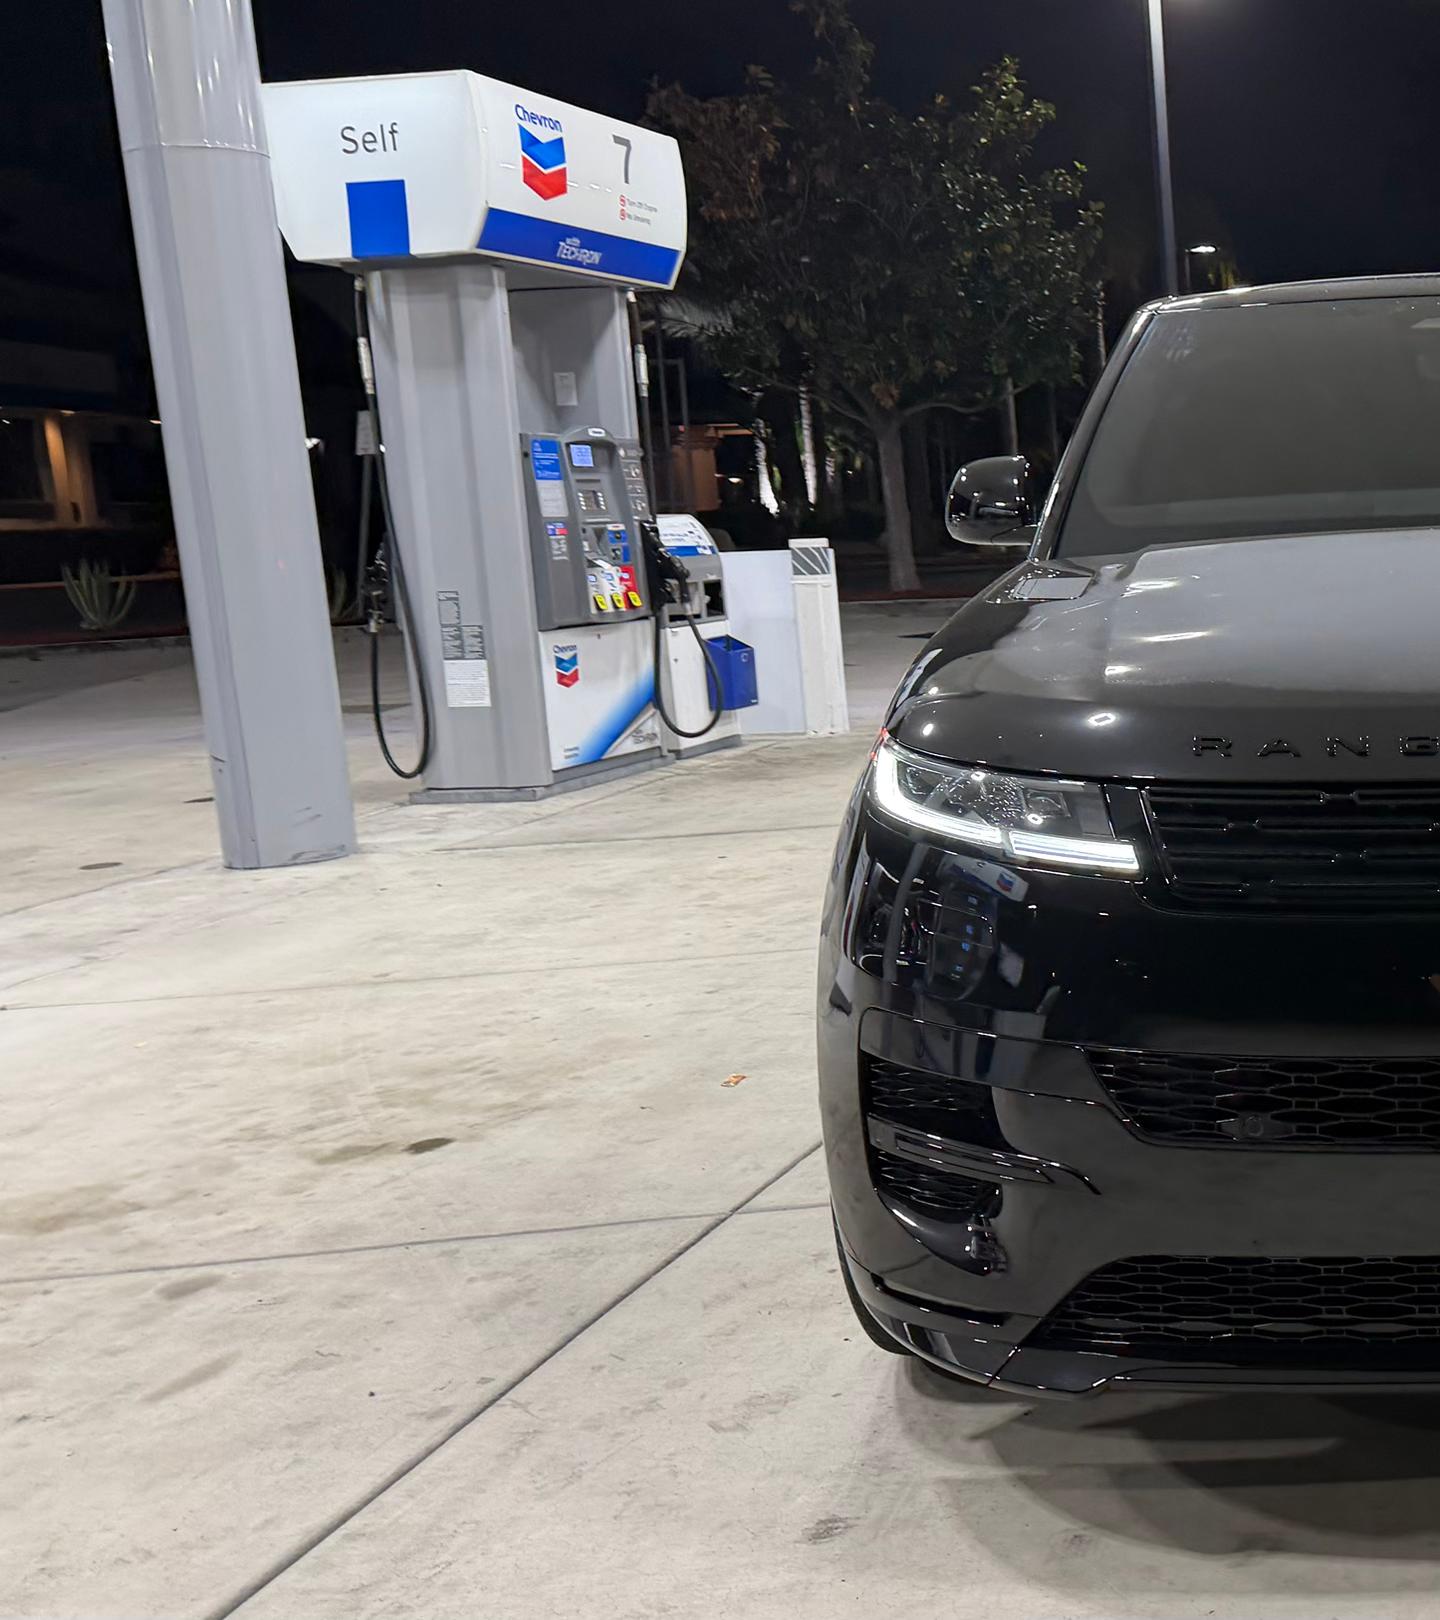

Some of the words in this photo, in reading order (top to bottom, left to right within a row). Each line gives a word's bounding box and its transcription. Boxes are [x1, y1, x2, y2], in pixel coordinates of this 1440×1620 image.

[514, 104, 563, 133] Chevron
[340, 122, 400, 155] Self
[612, 134, 632, 185] 7
